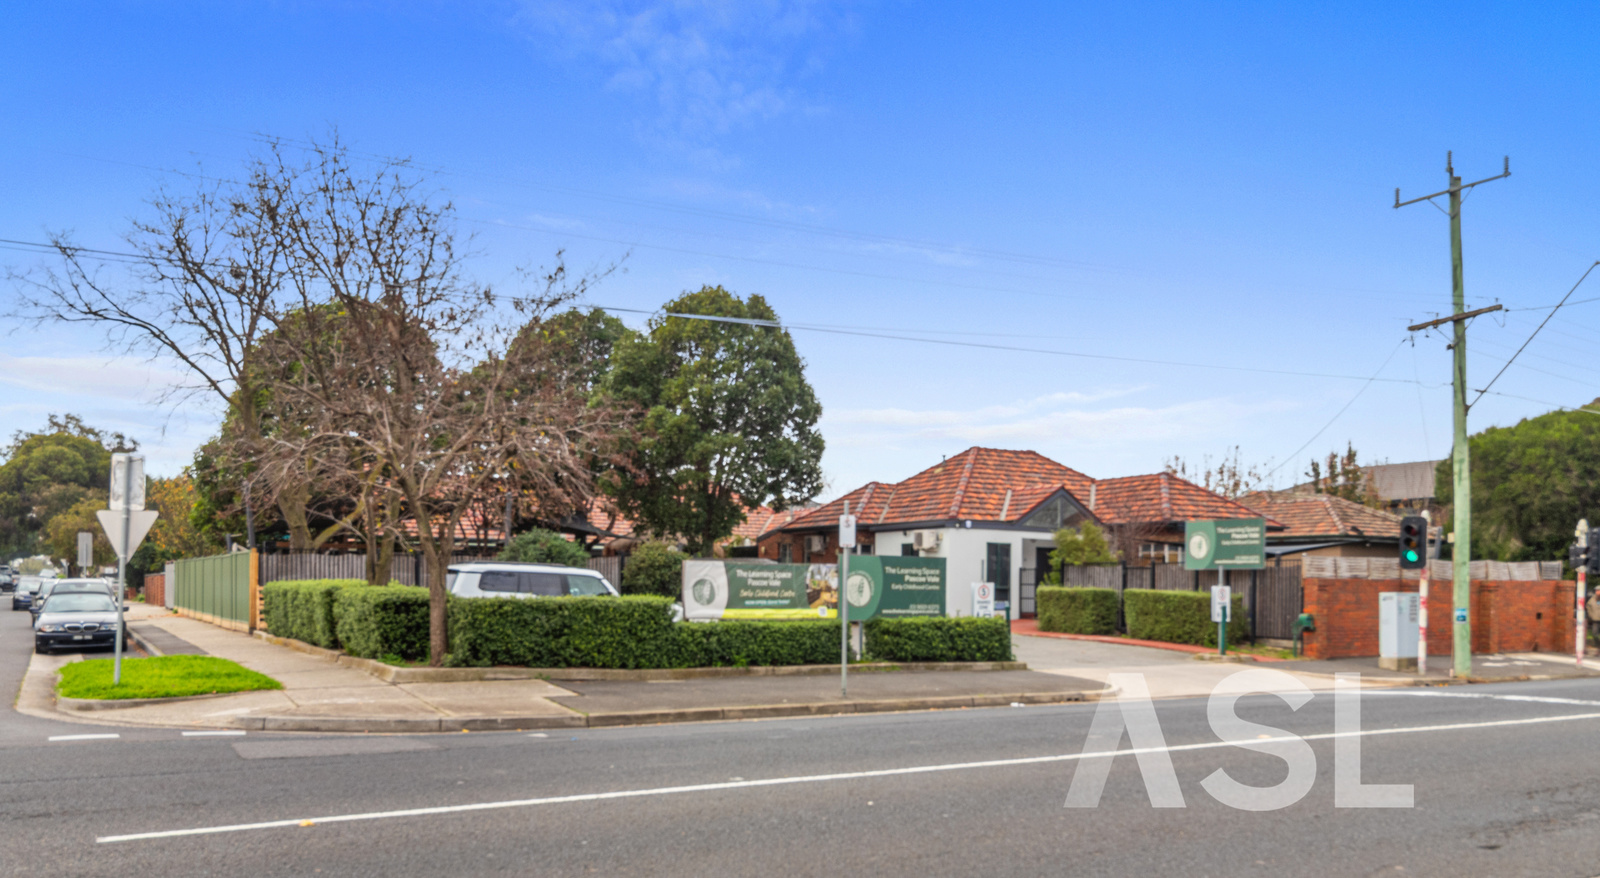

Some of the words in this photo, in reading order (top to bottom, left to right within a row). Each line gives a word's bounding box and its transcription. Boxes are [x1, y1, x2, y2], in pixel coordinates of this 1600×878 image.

[736, 570, 747, 578] The
[748, 570, 774, 580] Learning
[774, 571, 792, 580] Space
[897, 567, 922, 576] Learning
[922, 568, 940, 577] Space
